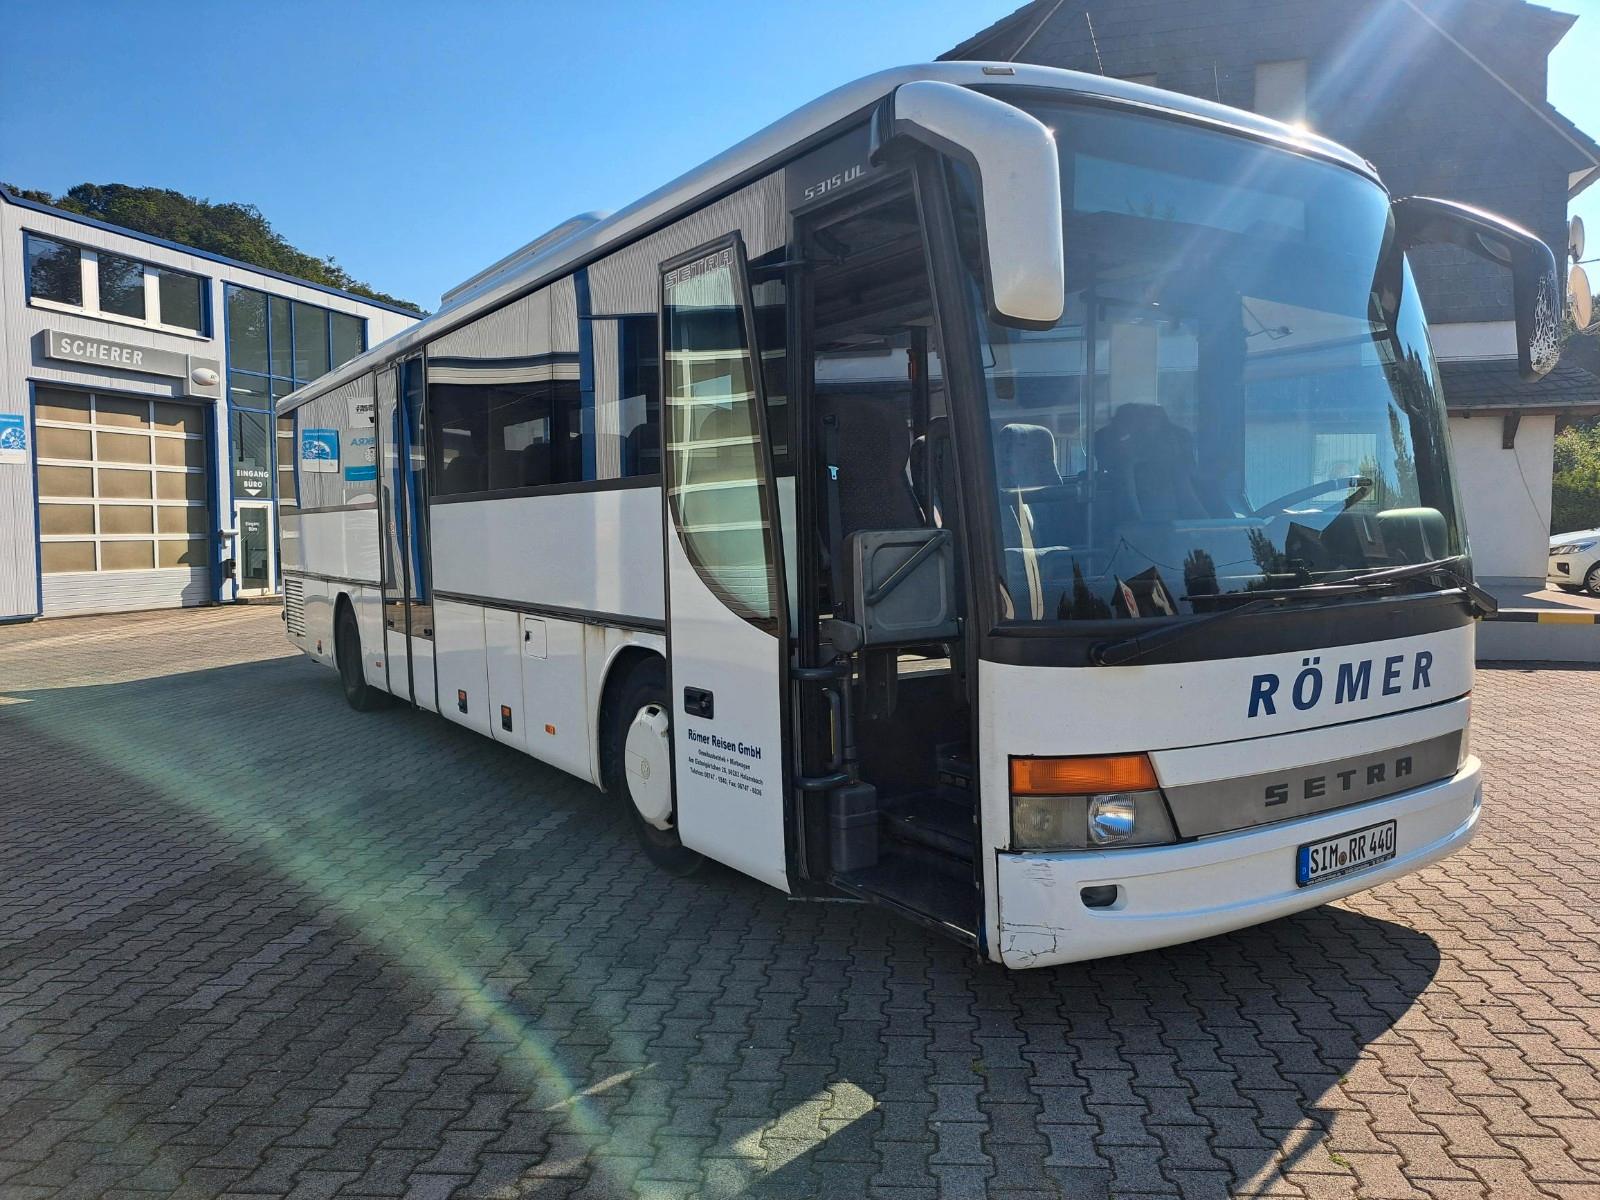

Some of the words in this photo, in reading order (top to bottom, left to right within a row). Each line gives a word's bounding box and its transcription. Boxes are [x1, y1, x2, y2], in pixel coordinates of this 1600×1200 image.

[663, 247, 735, 290] SETRA
[60, 338, 143, 365] SCHERER
[236, 469, 269, 478] EINGANG
[243, 479, 263, 488] BÜRO
[1247, 650, 1433, 718] RÖMER
[688, 728, 710, 744] Römer
[711, 734, 736, 752] Reisen
[738, 742, 761, 759] GmbH
[1264, 756, 1413, 807] SETRA
[1310, 843, 1338, 873] SIM
[1349, 835, 1366, 862] RR
[1370, 827, 1392, 855] 440
